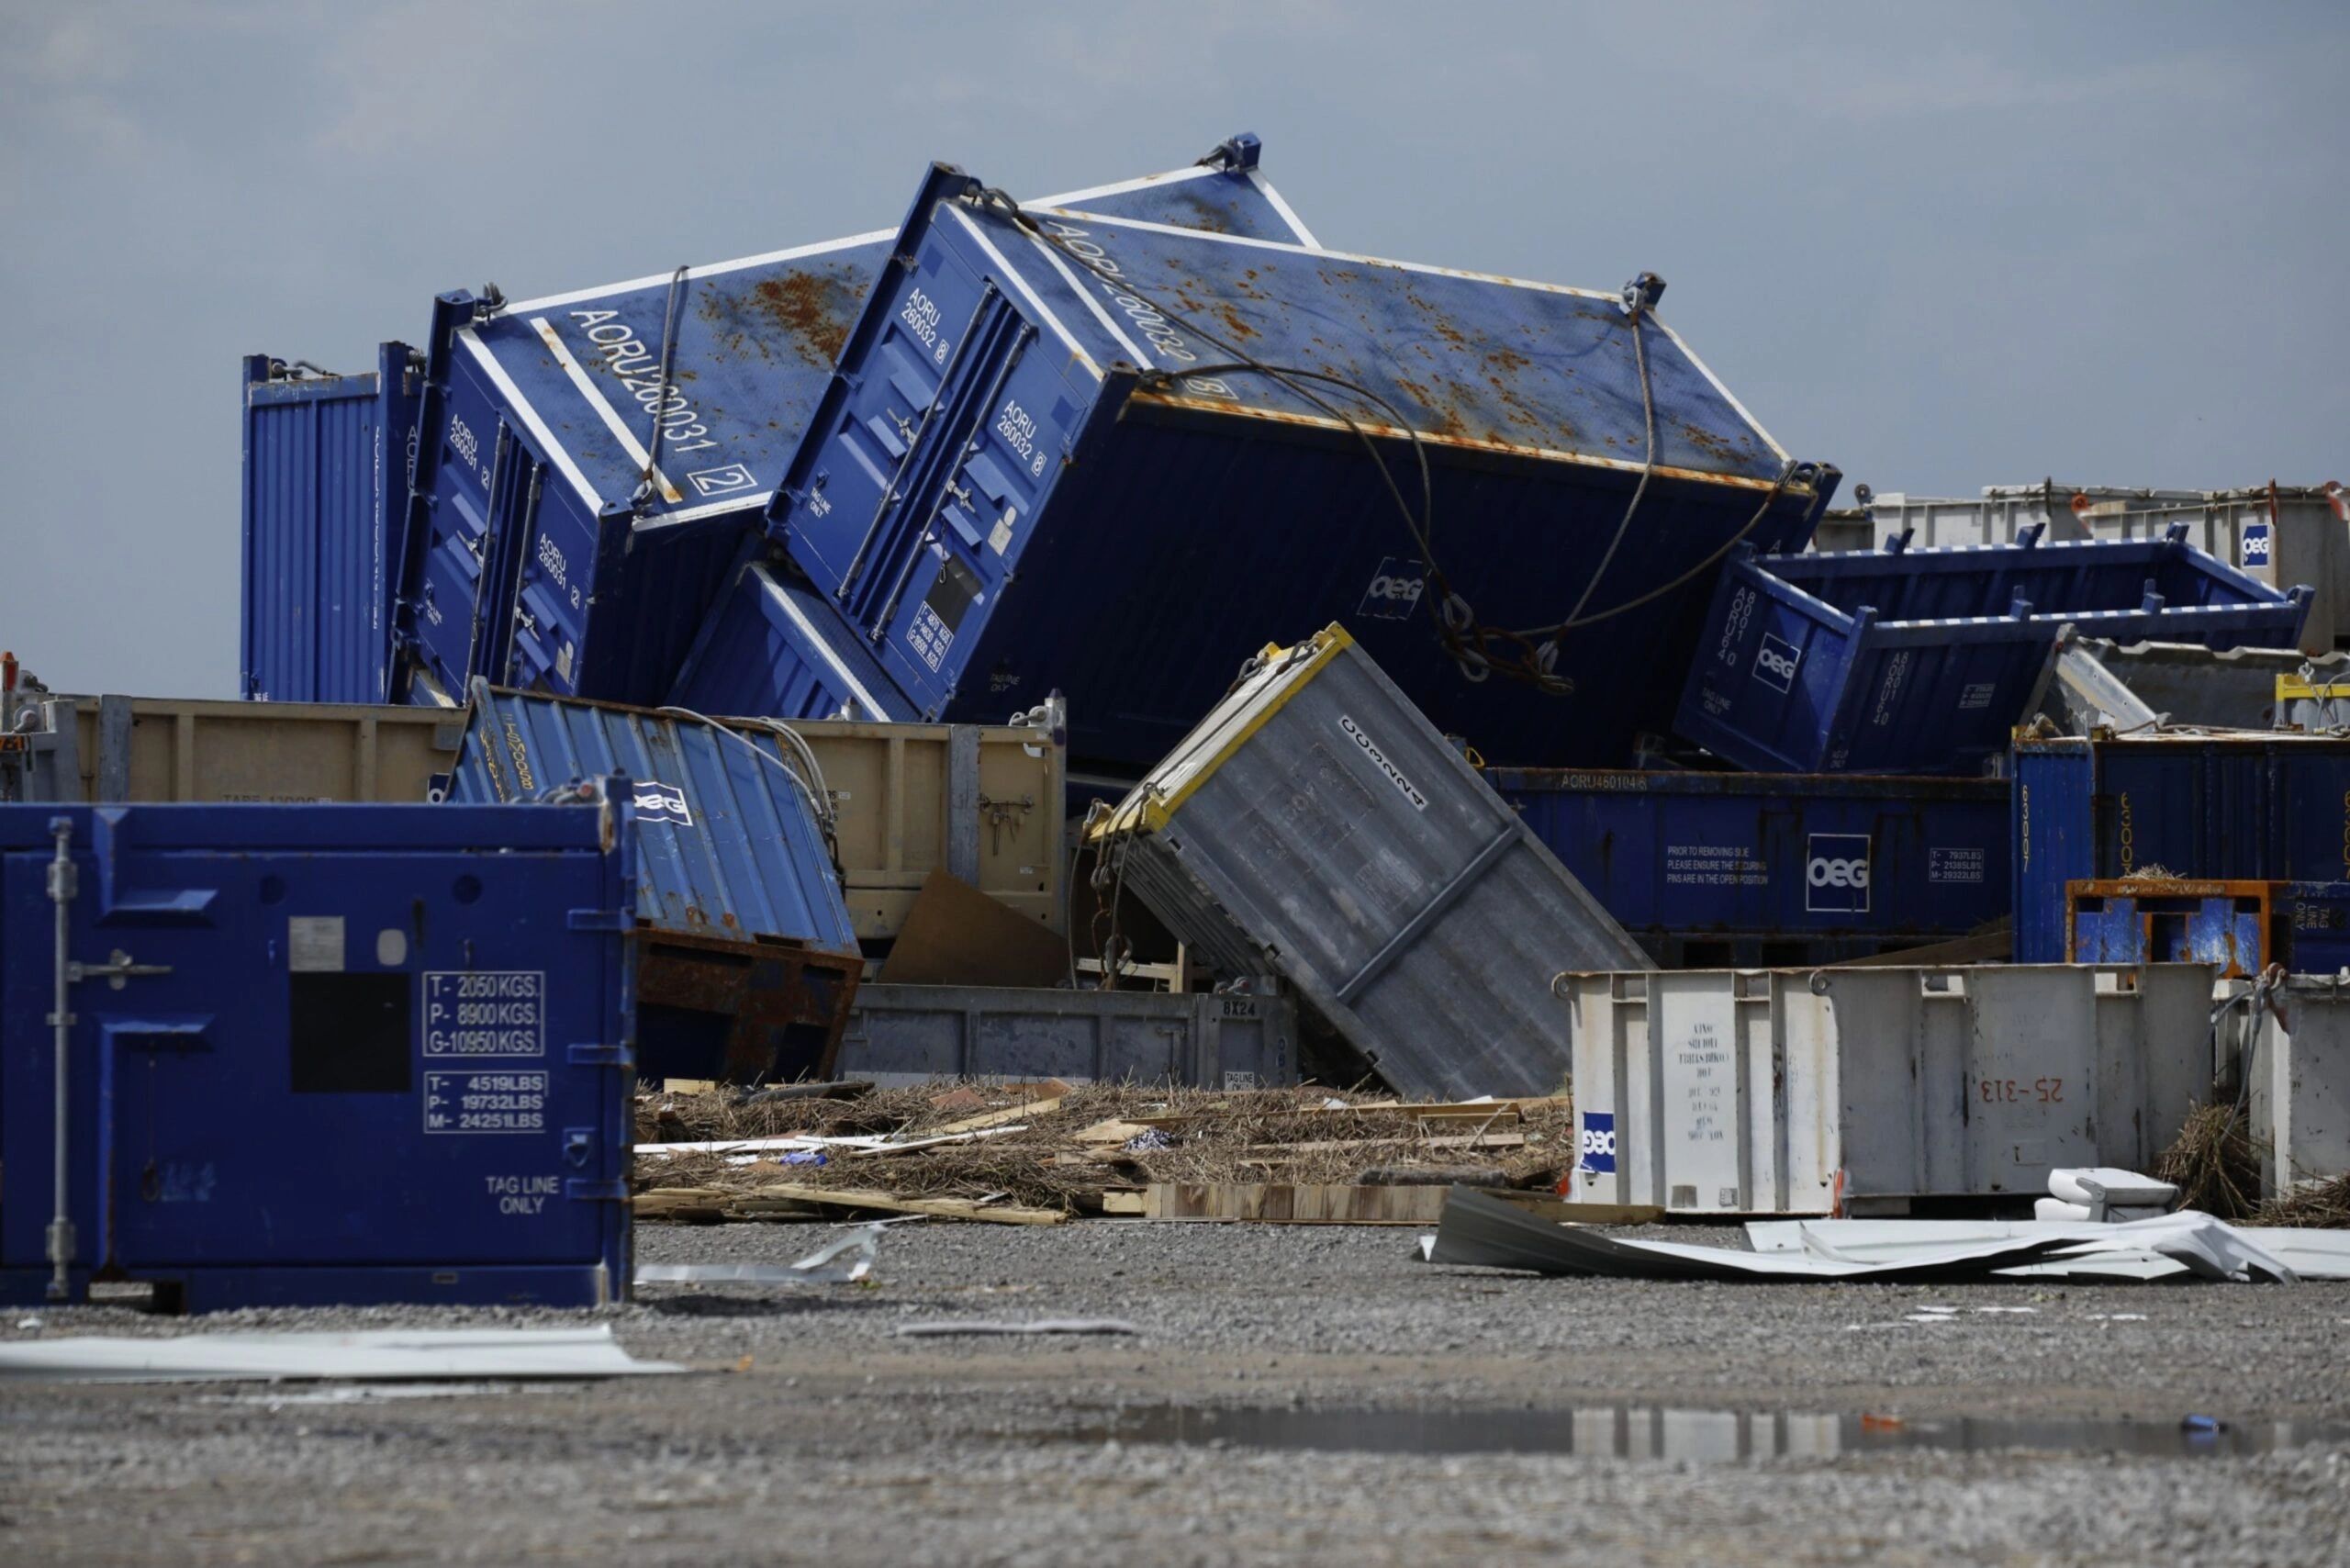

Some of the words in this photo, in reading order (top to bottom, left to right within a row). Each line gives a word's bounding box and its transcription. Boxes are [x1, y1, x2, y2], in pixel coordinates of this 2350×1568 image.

[910, 287, 941, 326] AORU
[901, 302, 936, 348] 260032
[570, 310, 718, 452] AORU260031
[1004, 400, 1036, 440] AORU
[452, 414, 477, 453] AORU
[997, 415, 1033, 461] 260032
[696, 471, 744, 491] 2
[540, 532, 566, 572] AORU
[1341, 718, 1425, 807] CC3224
[1667, 846, 1688, 857] PRIOR
[1688, 846, 1698, 856] TO
[1698, 846, 1733, 857] REMOVING
[1667, 859, 1693, 869] PLEASE
[1693, 860, 1719, 870] ENSURE
[1720, 861, 1734, 870] THE
[1683, 874, 1696, 883] ARE
[1697, 874, 1705, 883] IN
[1705, 874, 1719, 884] THE
[1719, 875, 1738, 884] OPEN
[1739, 875, 1769, 885] POSITION
[2295, 902, 2307, 931] ONLY
[2306, 905, 2319, 930] LINE
[2318, 907, 2331, 928] TAG
[429, 976, 451, 997] T-
[457, 976, 497, 997] 2050
[430, 1003, 451, 1025] P-
[457, 1003, 498, 1025] 8900
[429, 1077, 451, 1091] T-
[467, 1077, 543, 1091] 4519LBS
[1226, 1072, 1238, 1082] TAG
[1239, 1073, 1253, 1083] LINE
[1980, 1078, 2065, 1103] 25-313
[429, 1096, 450, 1109] P-
[461, 1095, 544, 1110] 19732LBS
[429, 1114, 453, 1128] M-
[459, 1114, 544, 1128] 24251LBS
[485, 1175, 520, 1194] TAG
[521, 1175, 560, 1194] LINE
[499, 1195, 545, 1215] ONLY
